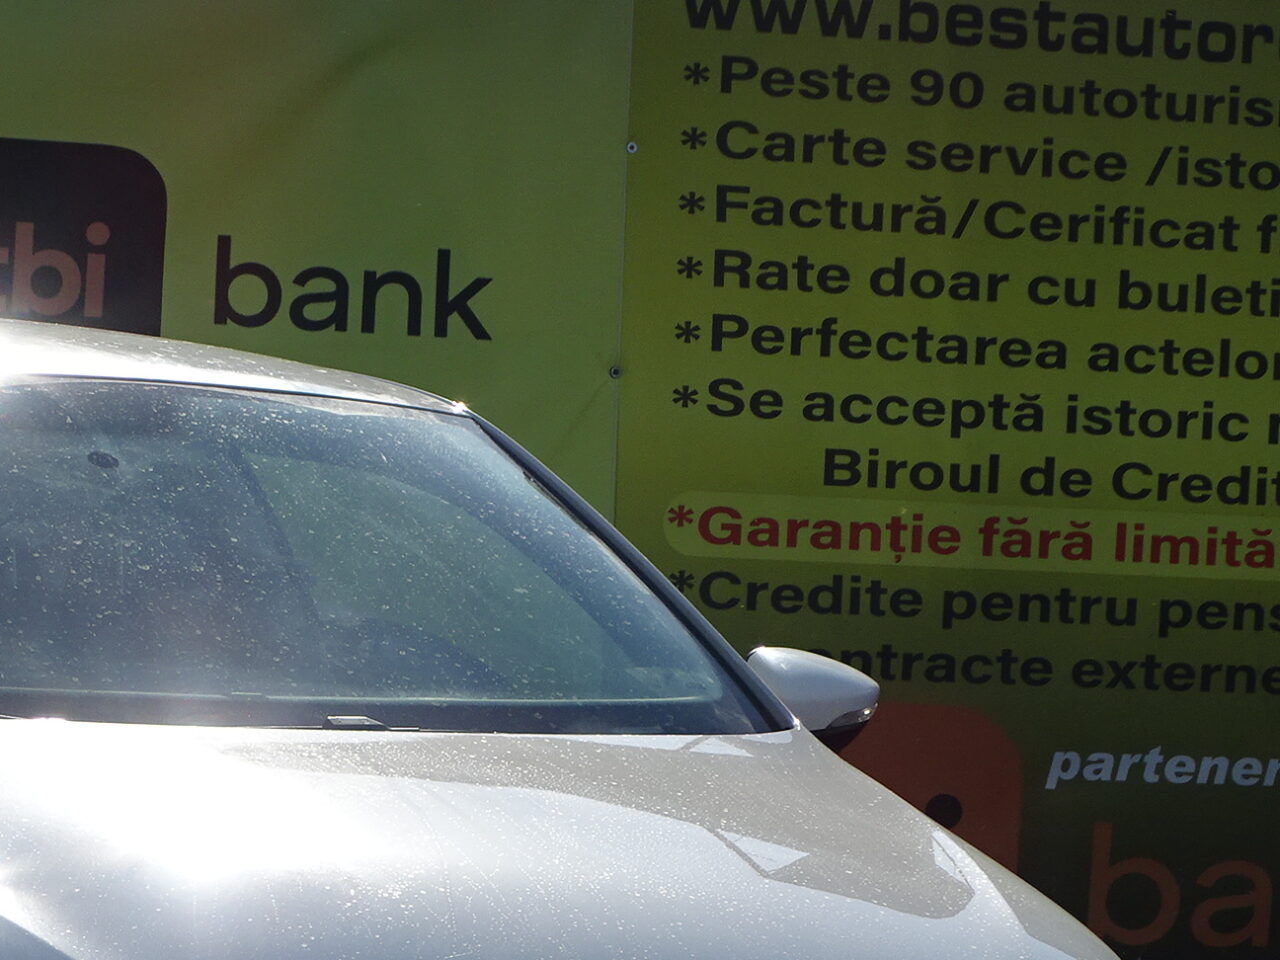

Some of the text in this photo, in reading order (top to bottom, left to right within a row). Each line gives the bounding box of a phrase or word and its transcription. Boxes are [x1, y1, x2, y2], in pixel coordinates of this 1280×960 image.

[683, 0, 1280, 64] www.bestautor
[910, 69, 985, 110] 90
[1003, 79, 1280, 128] autoturis
[905, 137, 1128, 182] service
[213, 234, 494, 341] bank
[870, 257, 1009, 303] doar
[1027, 274, 1096, 309] cu
[802, 392, 1045, 438] acceptă
[1065, 394, 1249, 442] istoric
[823, 448, 1001, 496] Biroul
[1020, 456, 1093, 498] de
[979, 515, 1094, 562] fără
[1115, 523, 1275, 569] limită
[942, 583, 1137, 630] pentru
[808, 642, 1053, 687] ntracte
